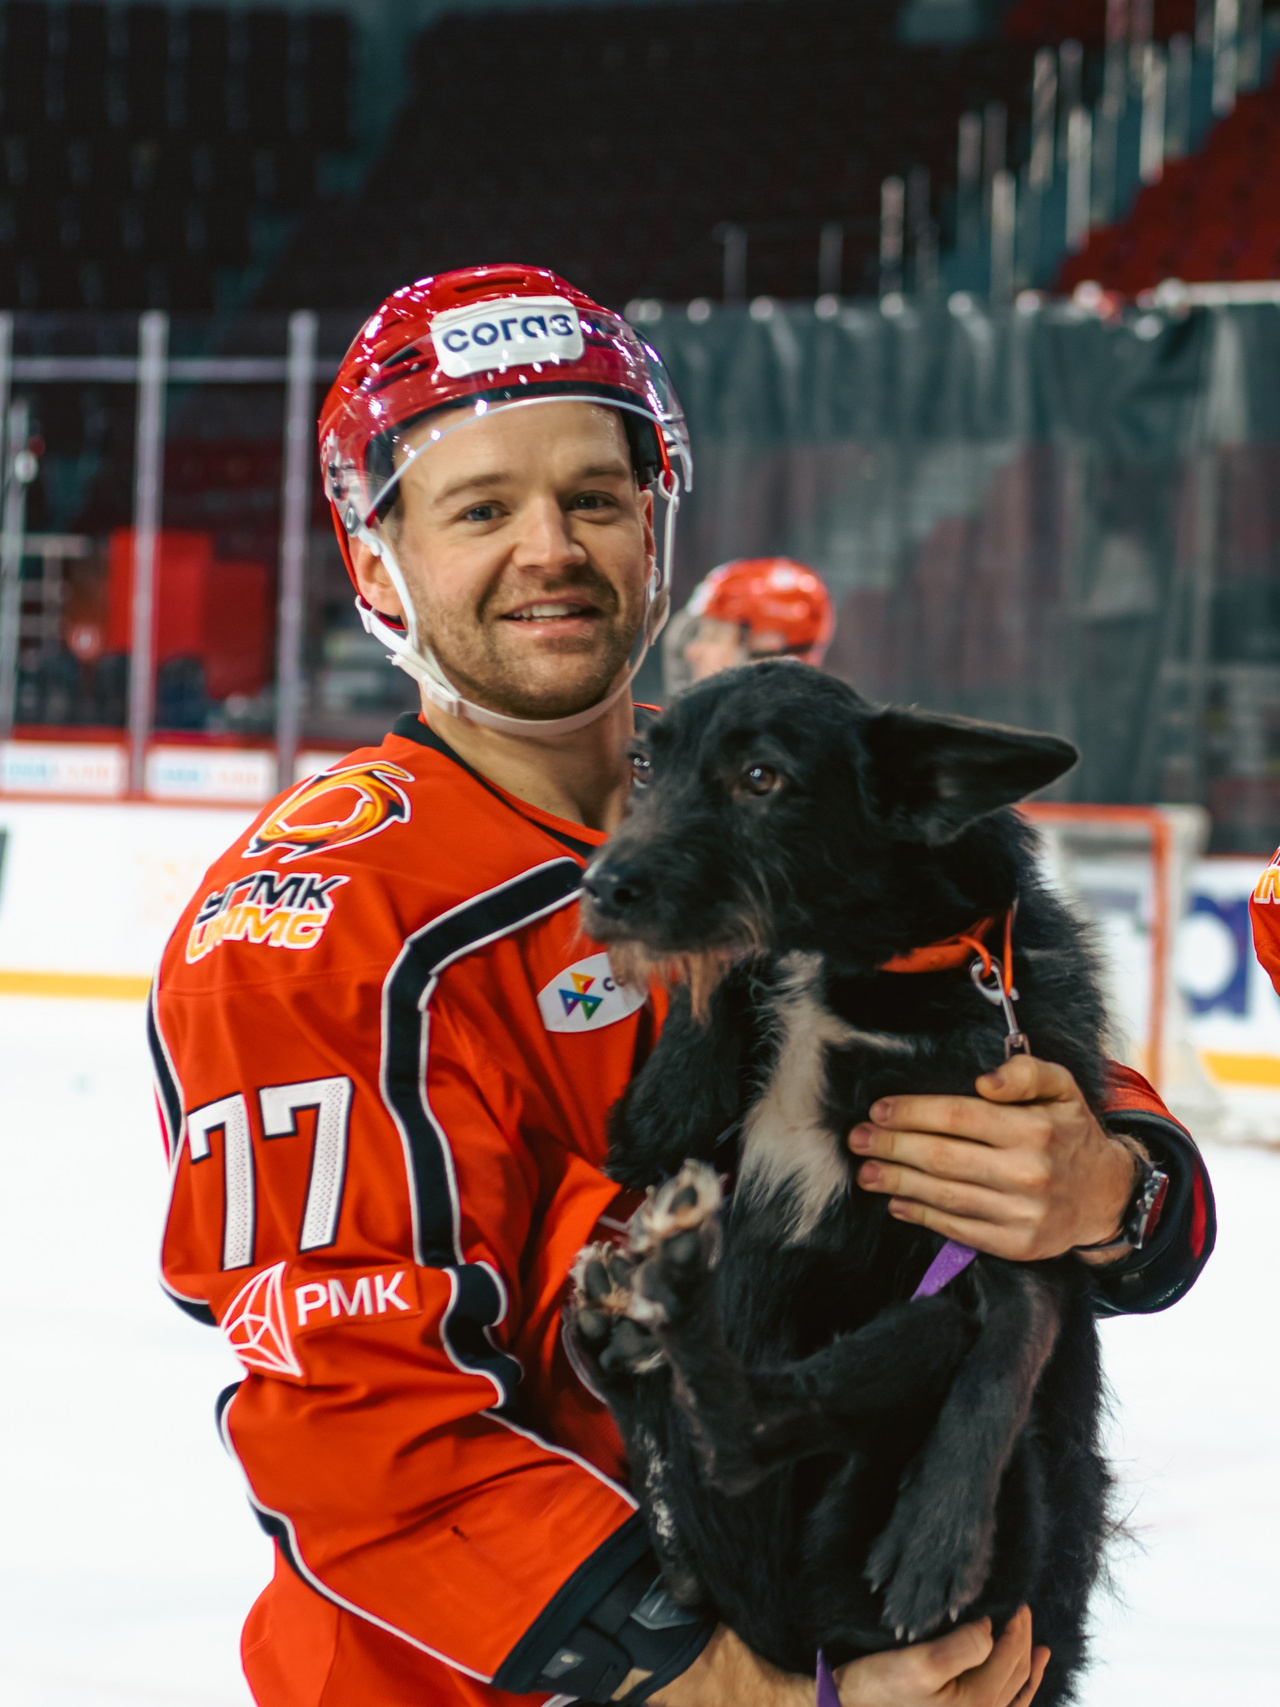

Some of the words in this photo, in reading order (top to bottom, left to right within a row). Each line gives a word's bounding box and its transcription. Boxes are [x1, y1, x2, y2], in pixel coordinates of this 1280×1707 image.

[441, 313, 574, 353] согаз
[186, 1074, 355, 1273] 77
[294, 1270, 411, 1327] РМК
